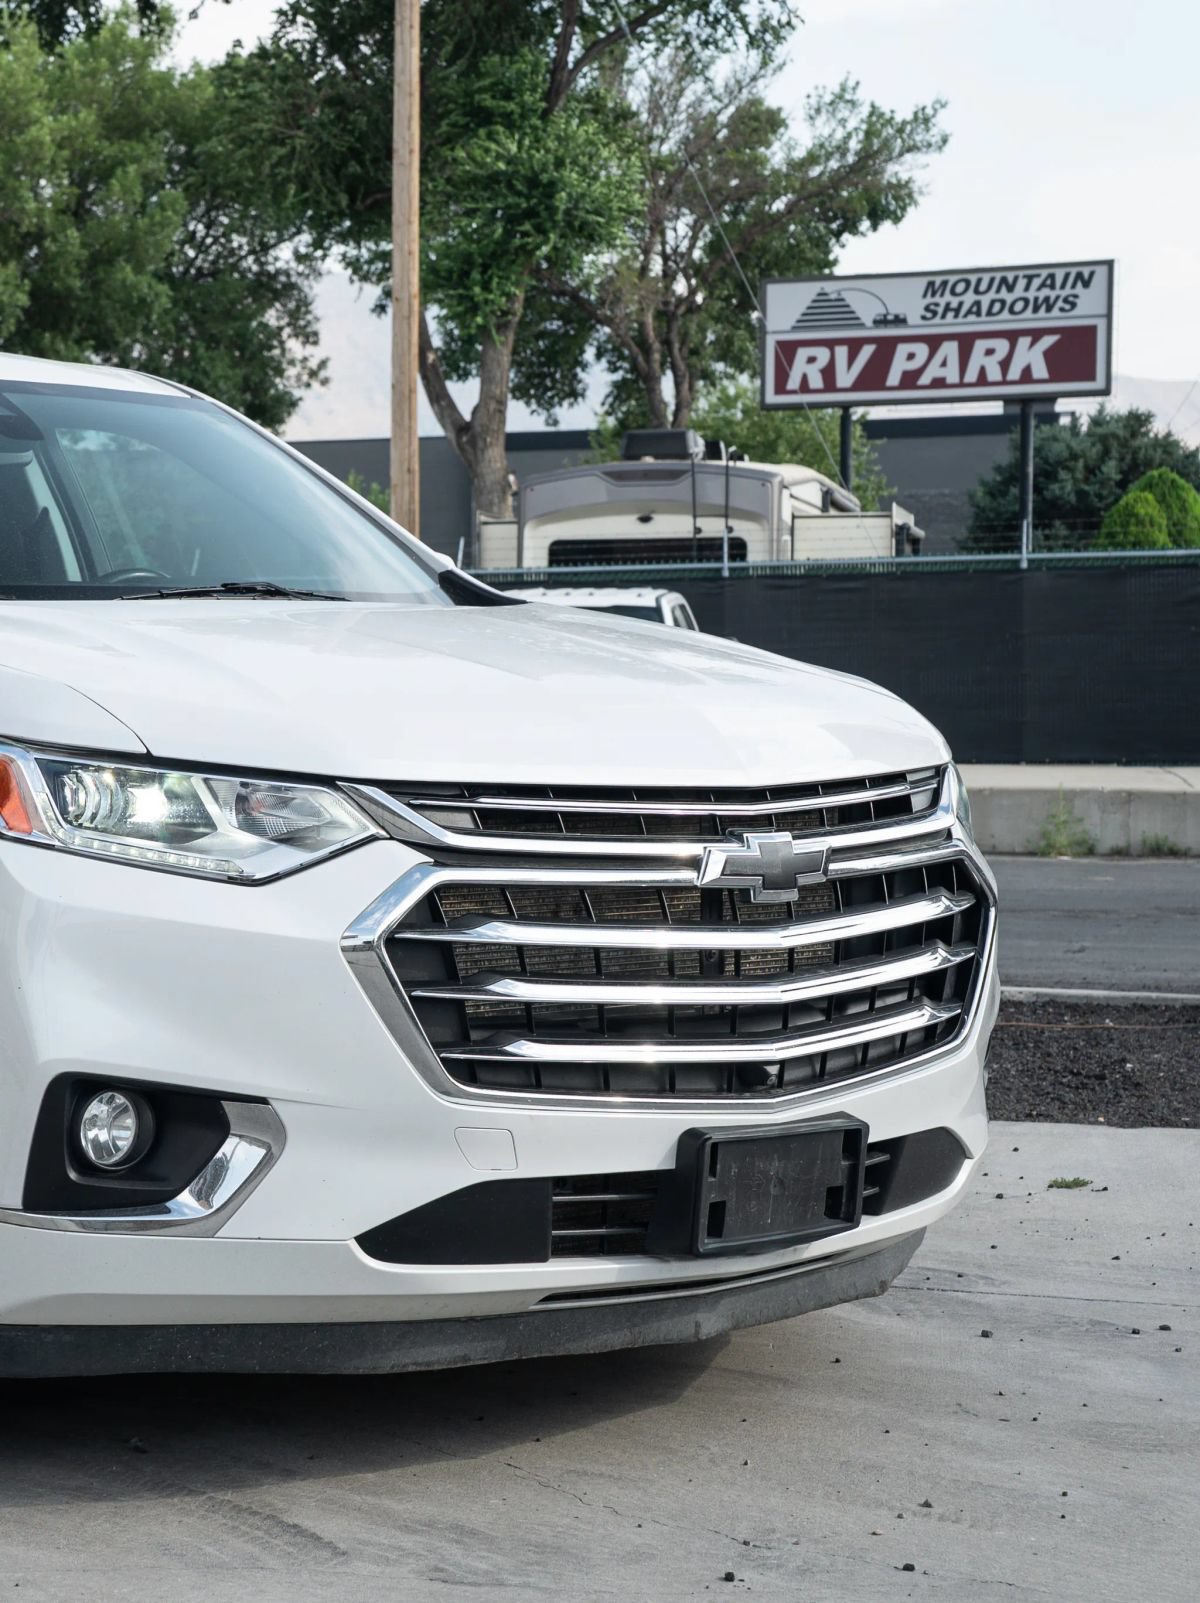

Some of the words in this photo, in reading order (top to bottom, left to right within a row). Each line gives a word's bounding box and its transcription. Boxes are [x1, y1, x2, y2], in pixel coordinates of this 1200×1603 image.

[922, 270, 1096, 299] MOUNTAIN
[920, 294, 1080, 321] SHADOWS
[785, 345, 877, 390] RV
[885, 334, 1061, 387] PARK
